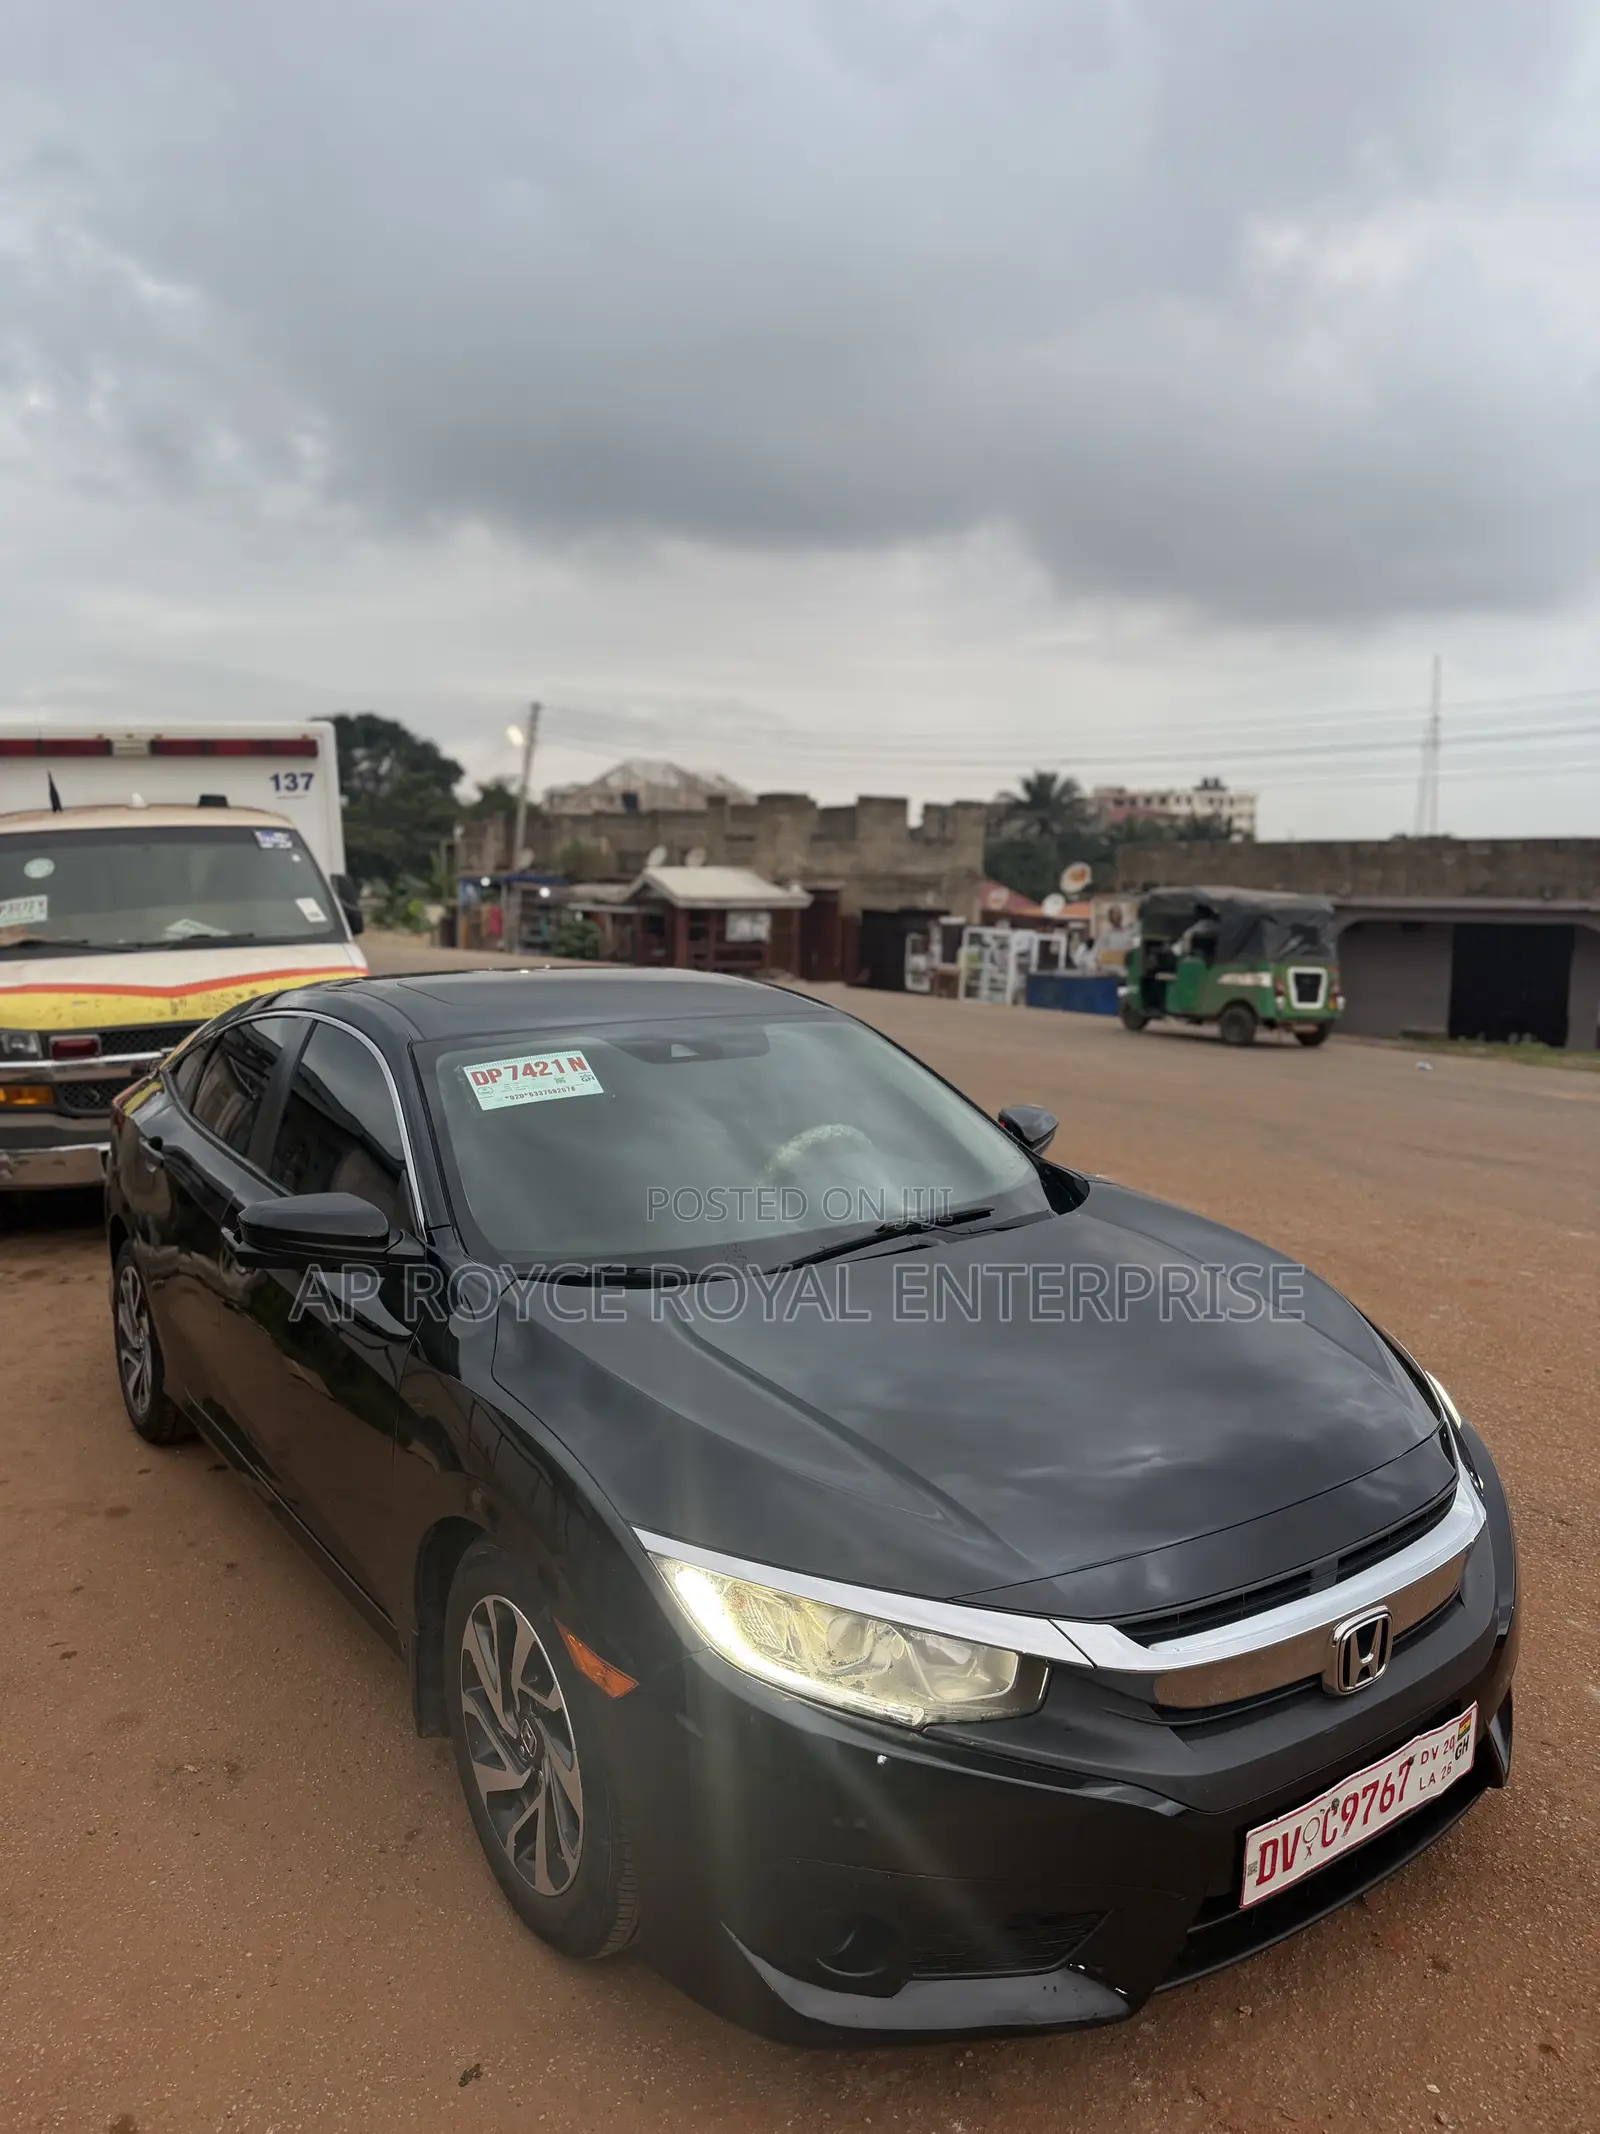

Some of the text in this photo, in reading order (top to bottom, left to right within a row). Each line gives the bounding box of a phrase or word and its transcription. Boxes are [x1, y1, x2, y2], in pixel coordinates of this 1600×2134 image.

[269, 772, 314, 792] 137
[470, 1056, 588, 1086] DP 7421 N
[1420, 1745, 1439, 1765] DV
[1454, 1734, 1469, 1761] GH
[1419, 1771, 1436, 1791] LA
[1255, 1757, 1415, 1886] DV C9767
